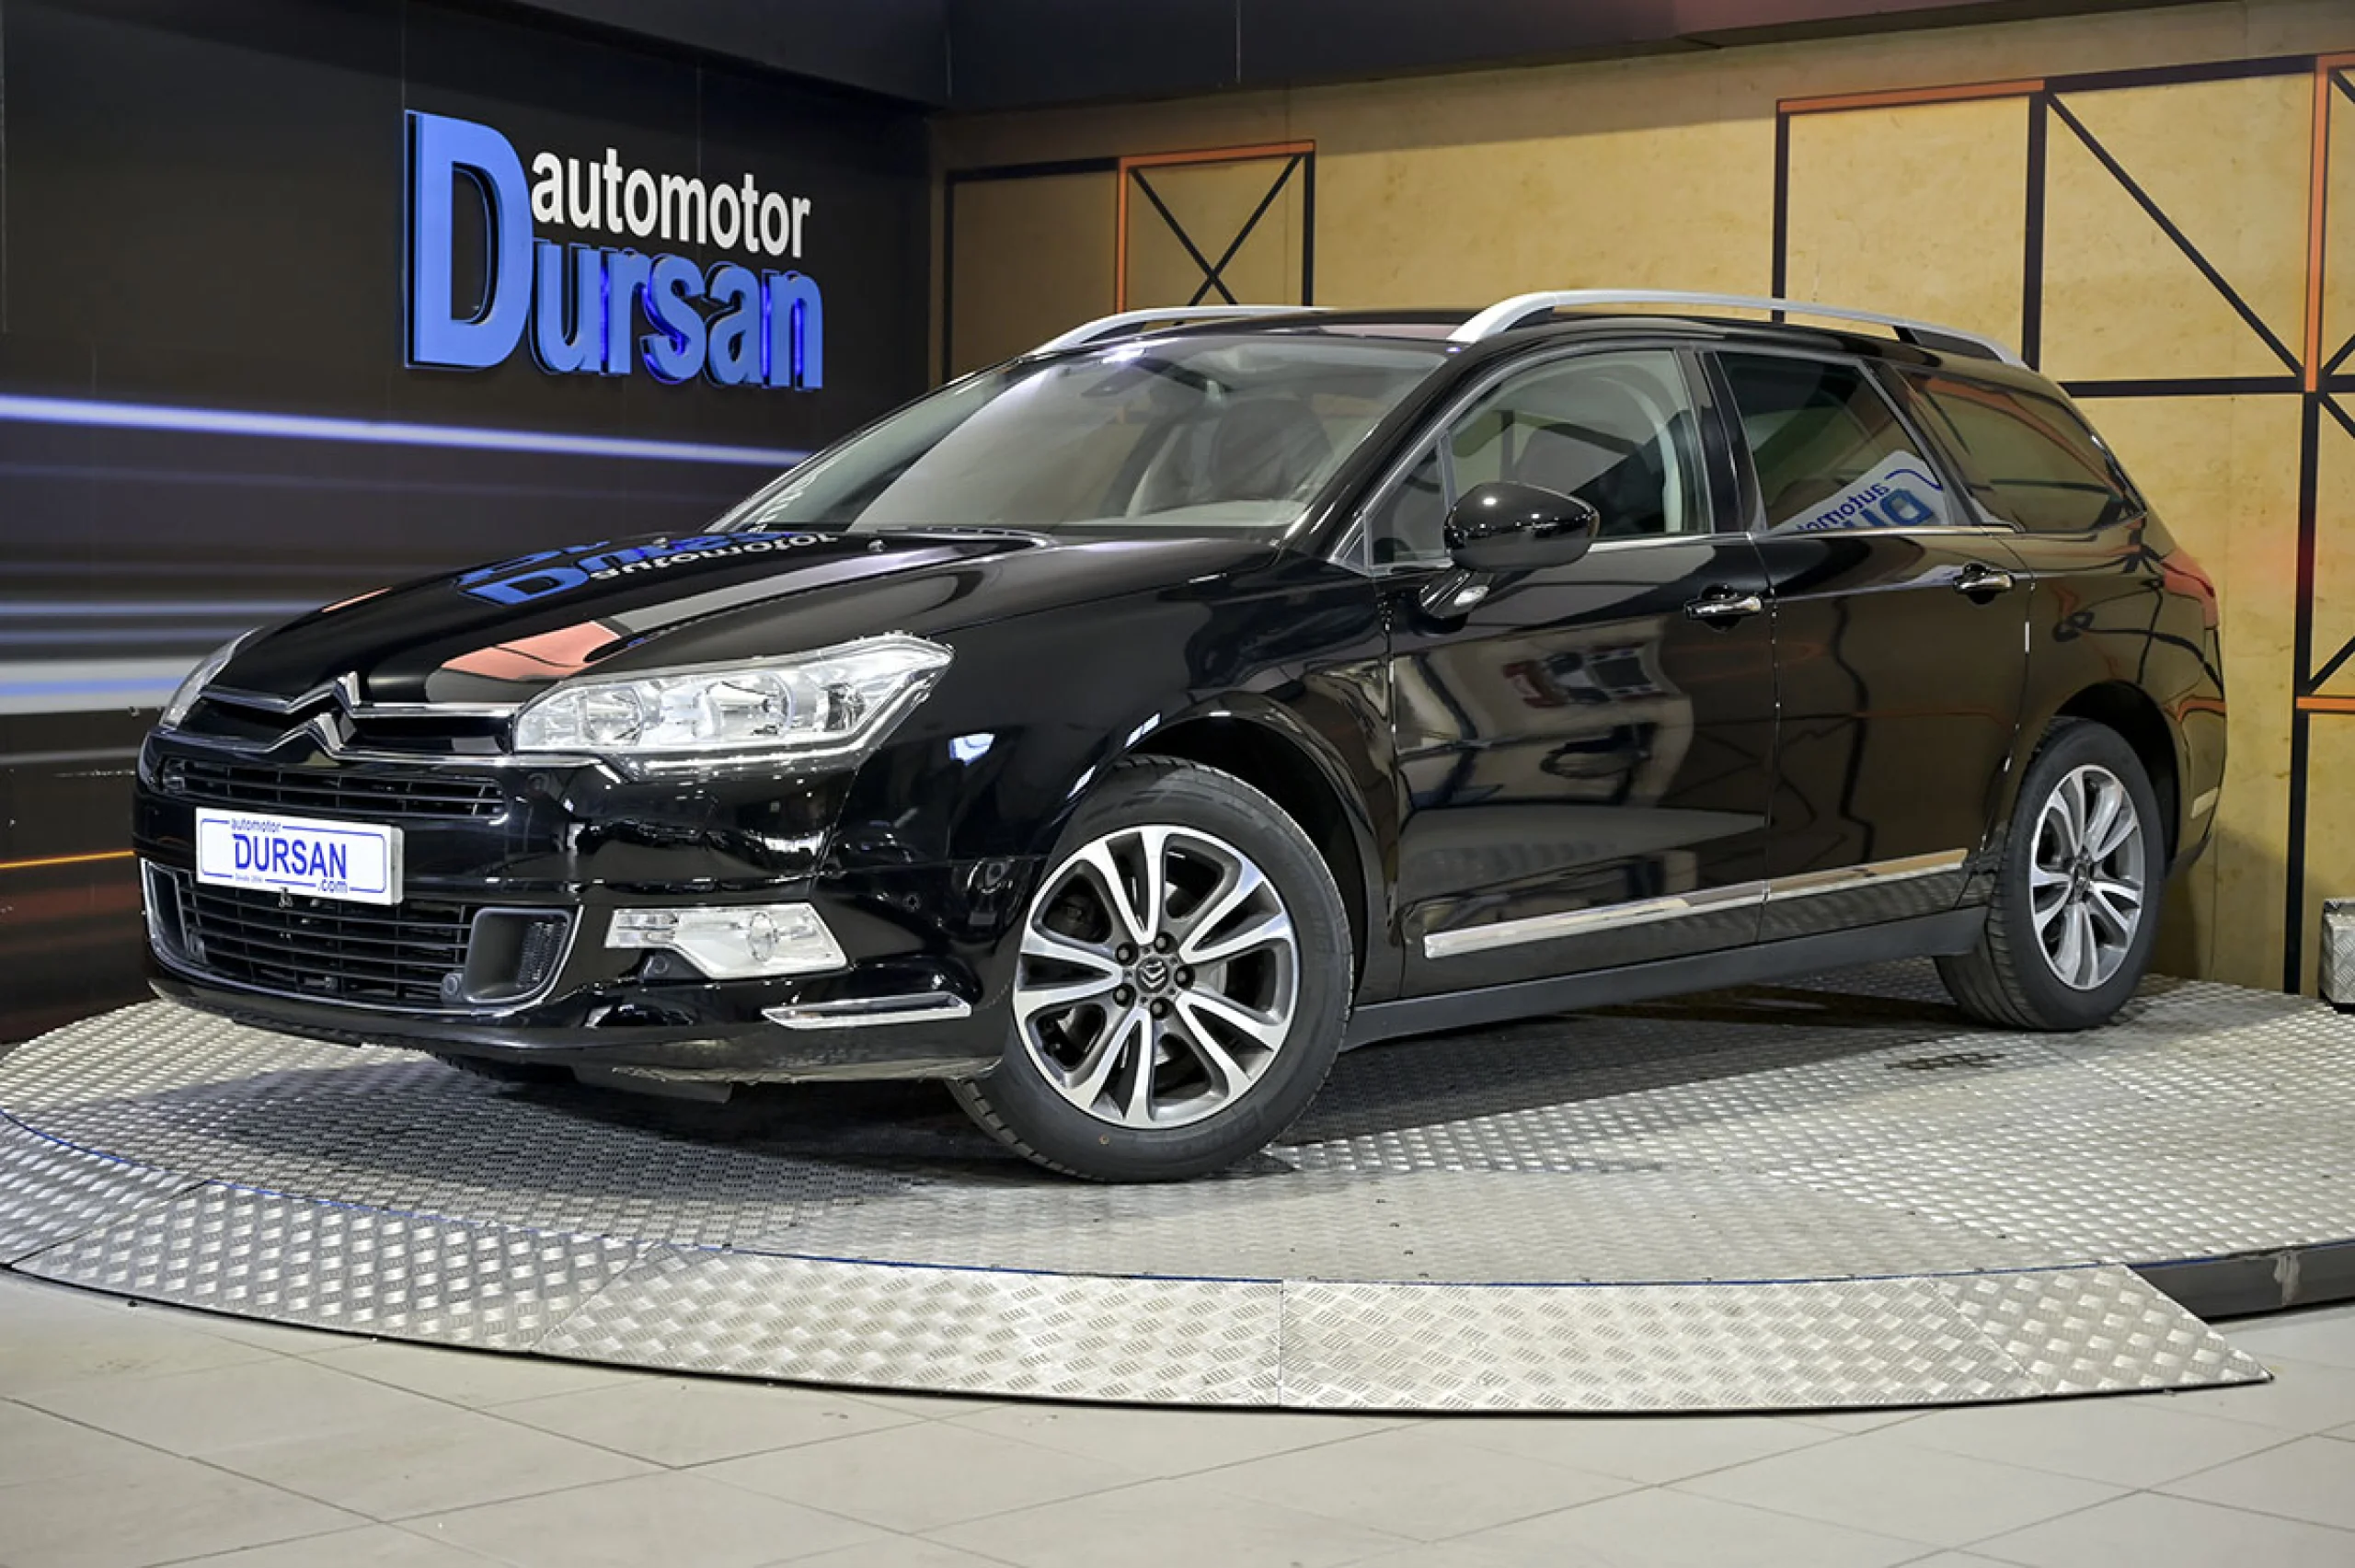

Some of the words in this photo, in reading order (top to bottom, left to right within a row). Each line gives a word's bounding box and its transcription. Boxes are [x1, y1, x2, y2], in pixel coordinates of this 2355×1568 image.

[531, 147, 810, 258] automotor
[405, 109, 822, 391] Dursan
[231, 818, 281, 833] automotor
[233, 833, 347, 879] DURSAN
[317, 878, 348, 894] .com
